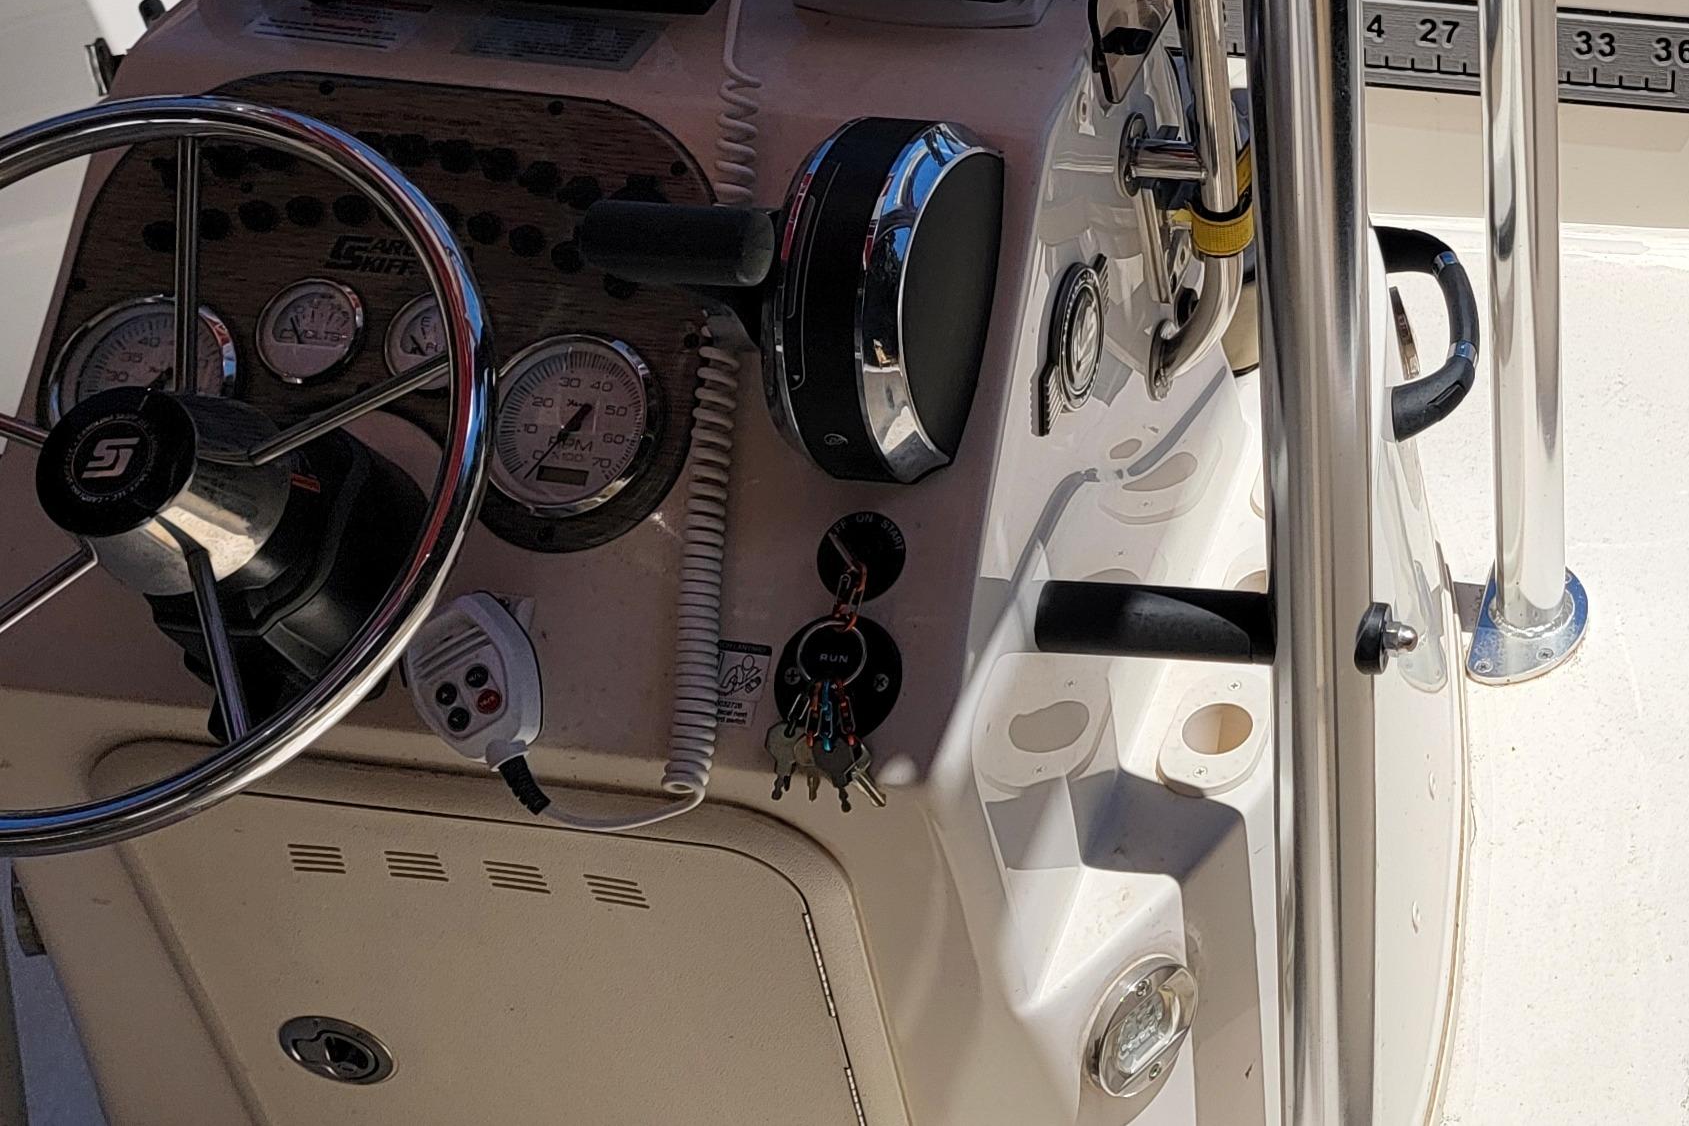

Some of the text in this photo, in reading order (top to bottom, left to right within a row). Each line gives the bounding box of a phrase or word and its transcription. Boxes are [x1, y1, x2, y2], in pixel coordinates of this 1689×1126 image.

[1366, 15, 1385, 38] 4
[1419, 18, 1461, 46] 27
[1575, 31, 1617, 58] 33
[559, 376, 581, 389] 30
[590, 381, 613, 393] 40
[531, 397, 554, 409] 20
[605, 404, 628, 417] 50
[524, 423, 538, 435] 10
[603, 433, 626, 445] 60
[592, 457, 613, 469] 70
[855, 513, 874, 524] ON
[880, 519, 906, 551] START
[819, 652, 850, 664] RUN
